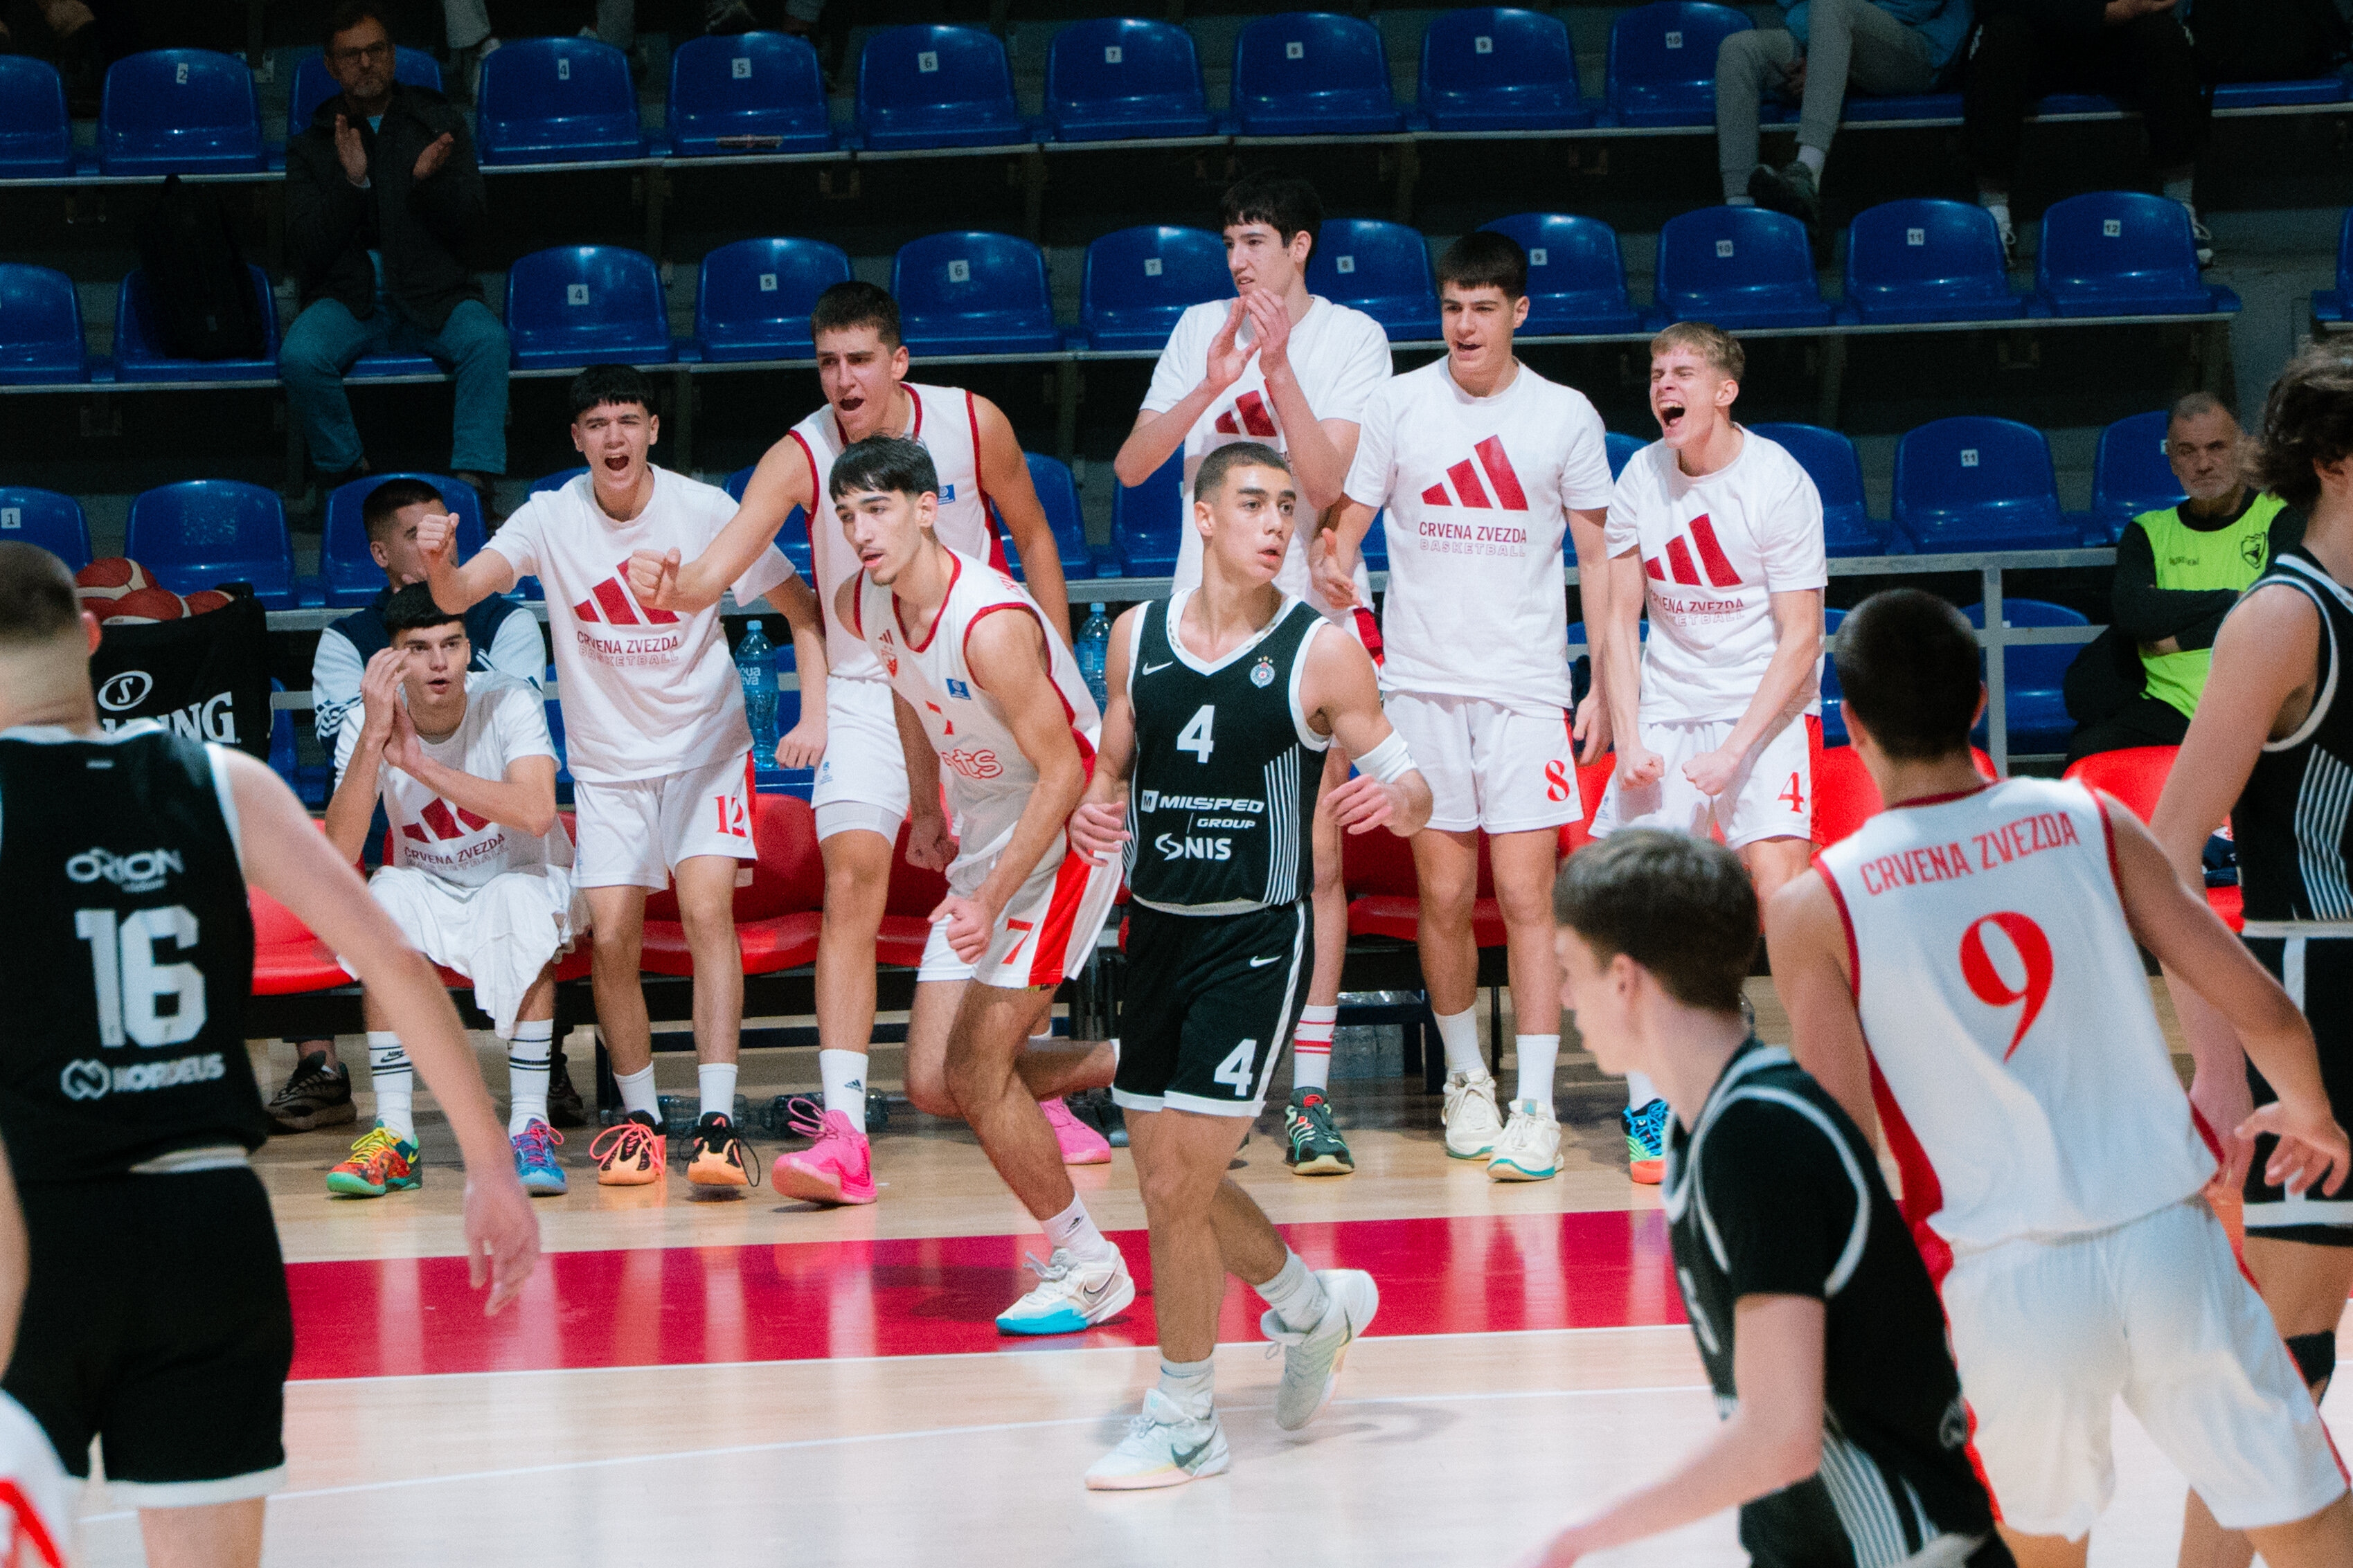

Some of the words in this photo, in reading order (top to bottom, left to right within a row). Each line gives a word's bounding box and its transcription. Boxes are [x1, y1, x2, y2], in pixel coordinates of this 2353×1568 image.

[560, 64, 567, 76] 4
[737, 62, 746, 75] 5
[924, 56, 932, 69] 6
[179, 69, 188, 81] 2
[1910, 232, 1922, 242] 11
[2106, 224, 2118, 233] 12
[955, 264, 963, 276] 6
[575, 289, 583, 300] 4
[1964, 453, 1976, 463] 11
[8, 513, 15, 525] 1
[1419, 521, 1472, 540] CRVENA
[1476, 526, 1527, 544] ZVEZDA
[1420, 539, 1526, 557] BASKETBALL
[577, 631, 623, 654] CRVENA
[627, 636, 679, 654] ZVEZDA
[579, 645, 679, 667] BASKETBALL
[1176, 705, 1215, 764] 4
[942, 748, 1003, 780] ts
[1545, 759, 1571, 802] 8
[1778, 771, 1805, 813] 4
[714, 795, 747, 838] 12
[1197, 818, 1256, 829] GROUP
[404, 846, 454, 865] CRVENA
[456, 833, 506, 863] ZVEZDA
[1185, 836, 1232, 860] NIS
[1859, 842, 1974, 896] CRVENA
[1971, 811, 2081, 871] ZVEZDA
[1001, 917, 1035, 965] 7
[74, 904, 207, 1048] 16
[1958, 910, 2055, 1065] 9
[1213, 1038, 1258, 1097] 4
